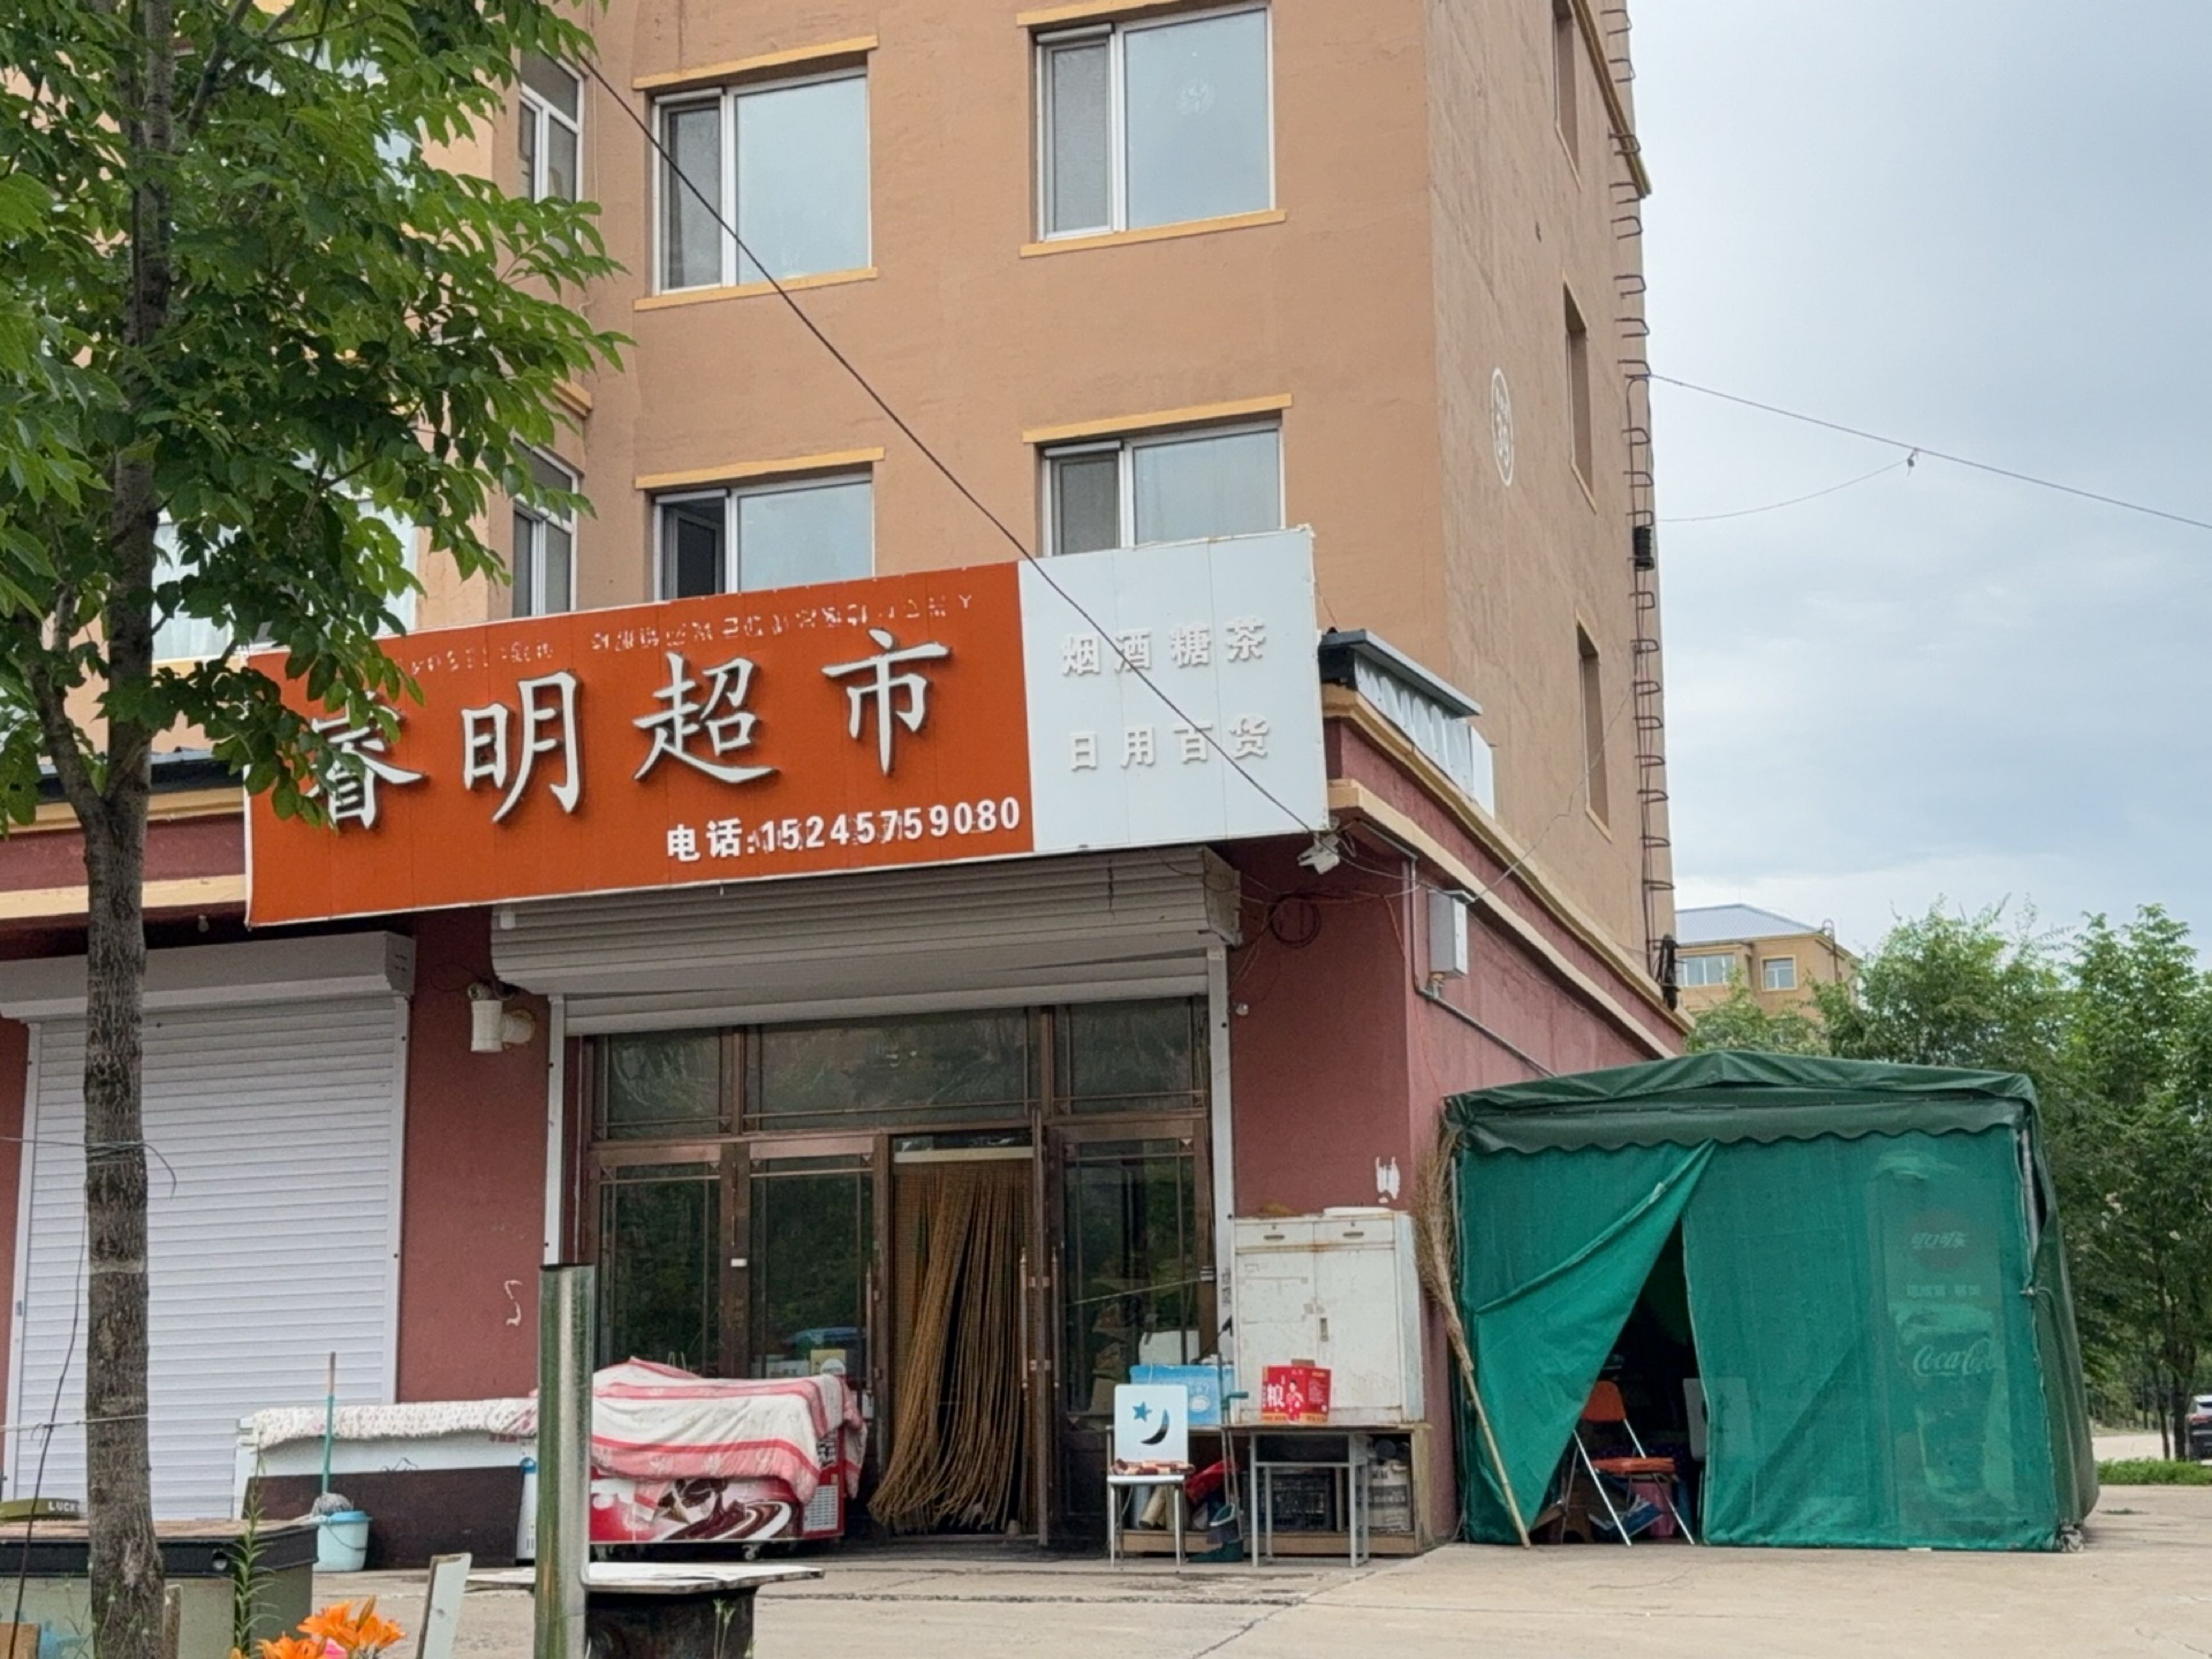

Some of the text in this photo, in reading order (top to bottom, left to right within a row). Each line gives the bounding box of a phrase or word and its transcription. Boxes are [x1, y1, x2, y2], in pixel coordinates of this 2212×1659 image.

[1061, 616, 1267, 678] 烟酒糖茶
[1070, 714, 1270, 773] 日用百货
